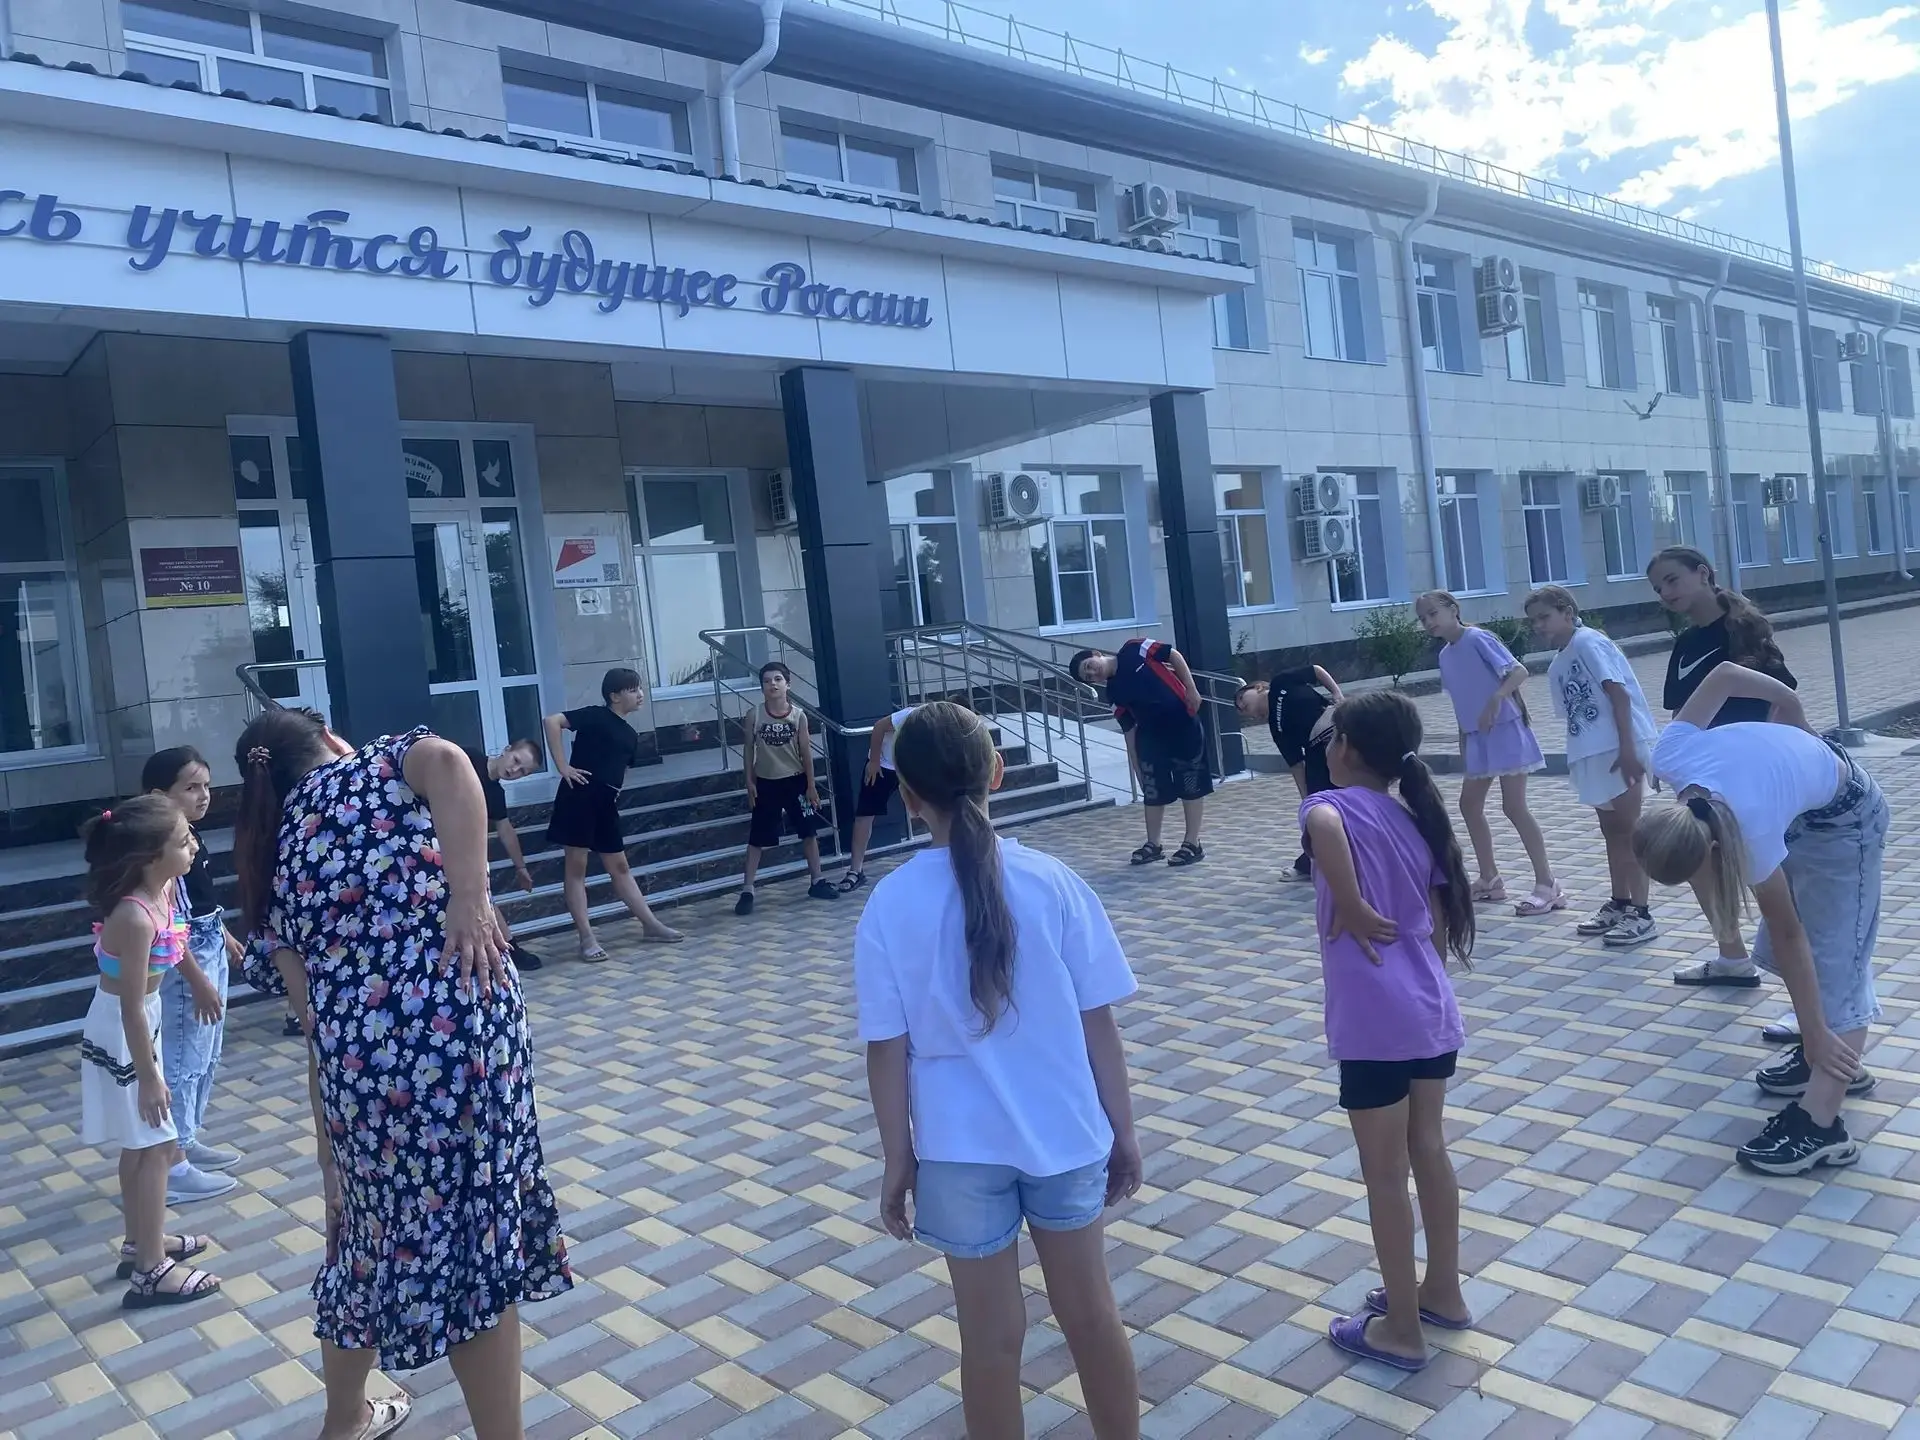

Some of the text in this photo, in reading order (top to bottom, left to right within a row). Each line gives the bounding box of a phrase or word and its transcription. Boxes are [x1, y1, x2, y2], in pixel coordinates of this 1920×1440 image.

[127, 205, 459, 279] учится
[490, 226, 738, 318] будущее
[761, 262, 933, 328] России
[180, 580, 210, 591] № 10
